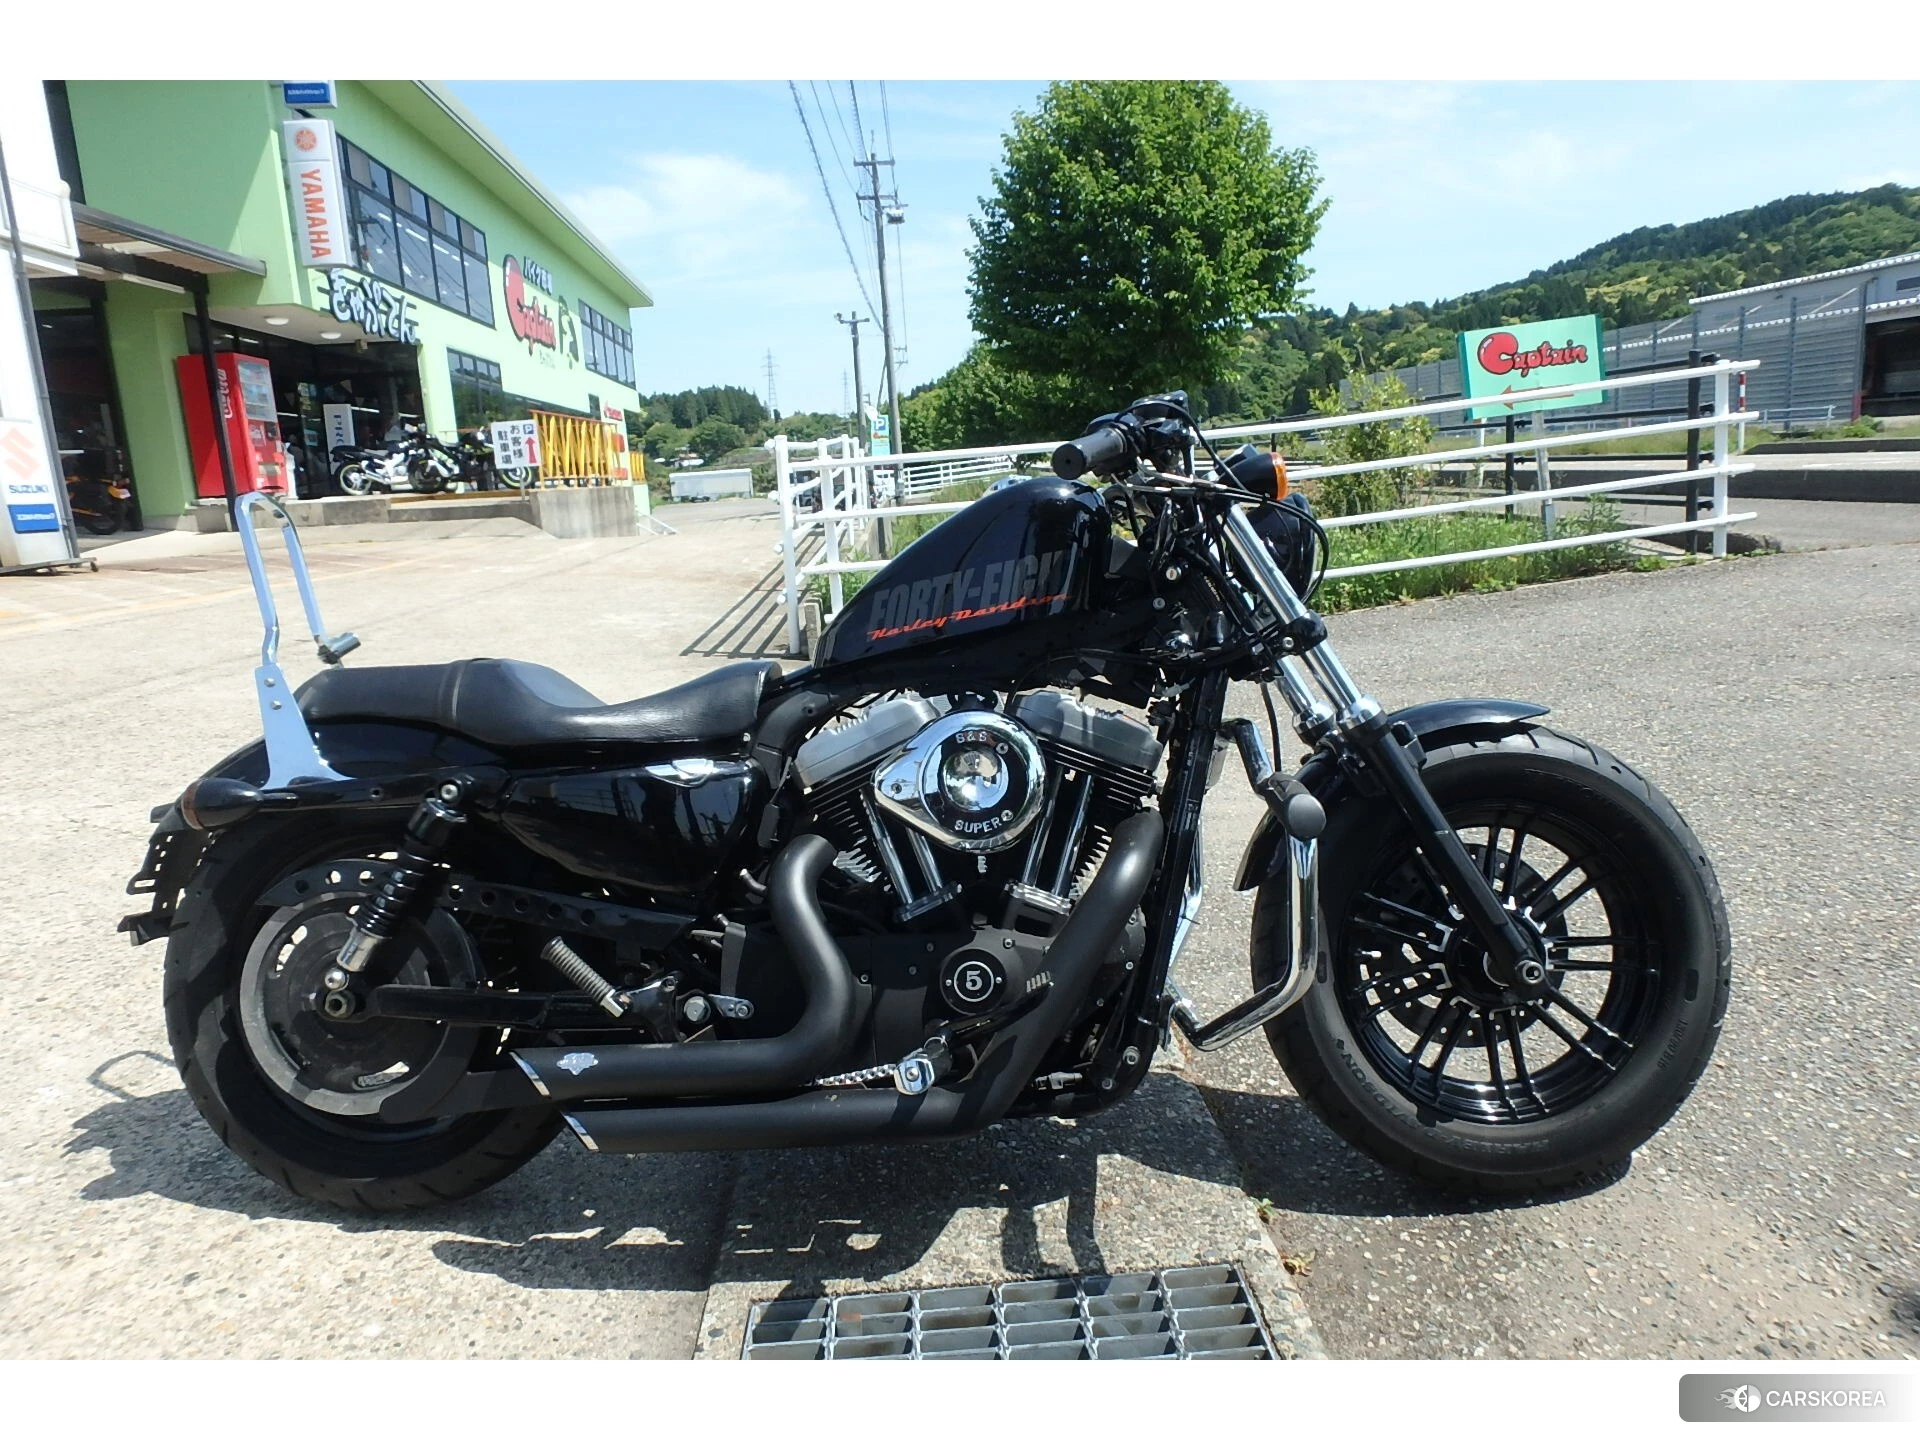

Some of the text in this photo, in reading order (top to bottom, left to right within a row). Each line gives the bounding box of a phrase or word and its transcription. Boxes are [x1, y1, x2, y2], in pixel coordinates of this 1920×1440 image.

[300, 168, 332, 258] YAMAHA
[1477, 331, 1589, 378] Captain
[8, 484, 48, 494] SUZUKI
[868, 550, 1065, 632] FORTY-EIGH
[955, 730, 987, 744] S&S
[954, 817, 1002, 834] SUPER
[965, 970, 983, 991] 5
